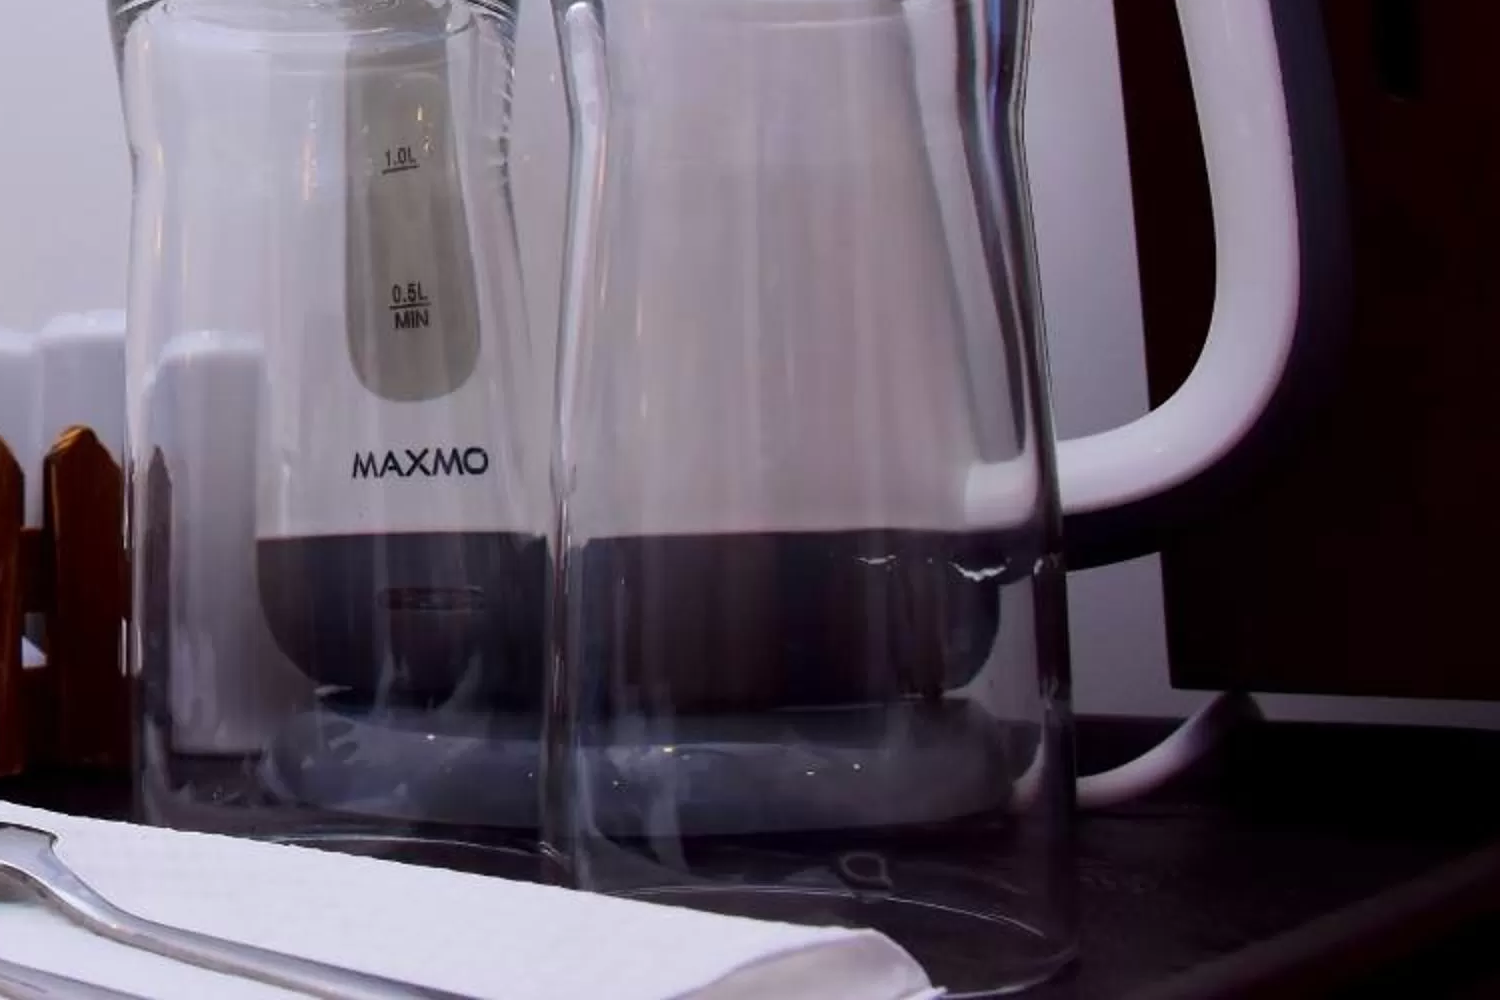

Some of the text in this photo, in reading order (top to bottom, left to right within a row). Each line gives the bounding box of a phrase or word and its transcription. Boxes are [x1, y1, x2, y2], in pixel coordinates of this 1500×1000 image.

[384, 147, 417, 167] 1.0L
[391, 281, 429, 304] 0.5L
[394, 309, 430, 329] MIN
[351, 447, 490, 479] MAXMO
